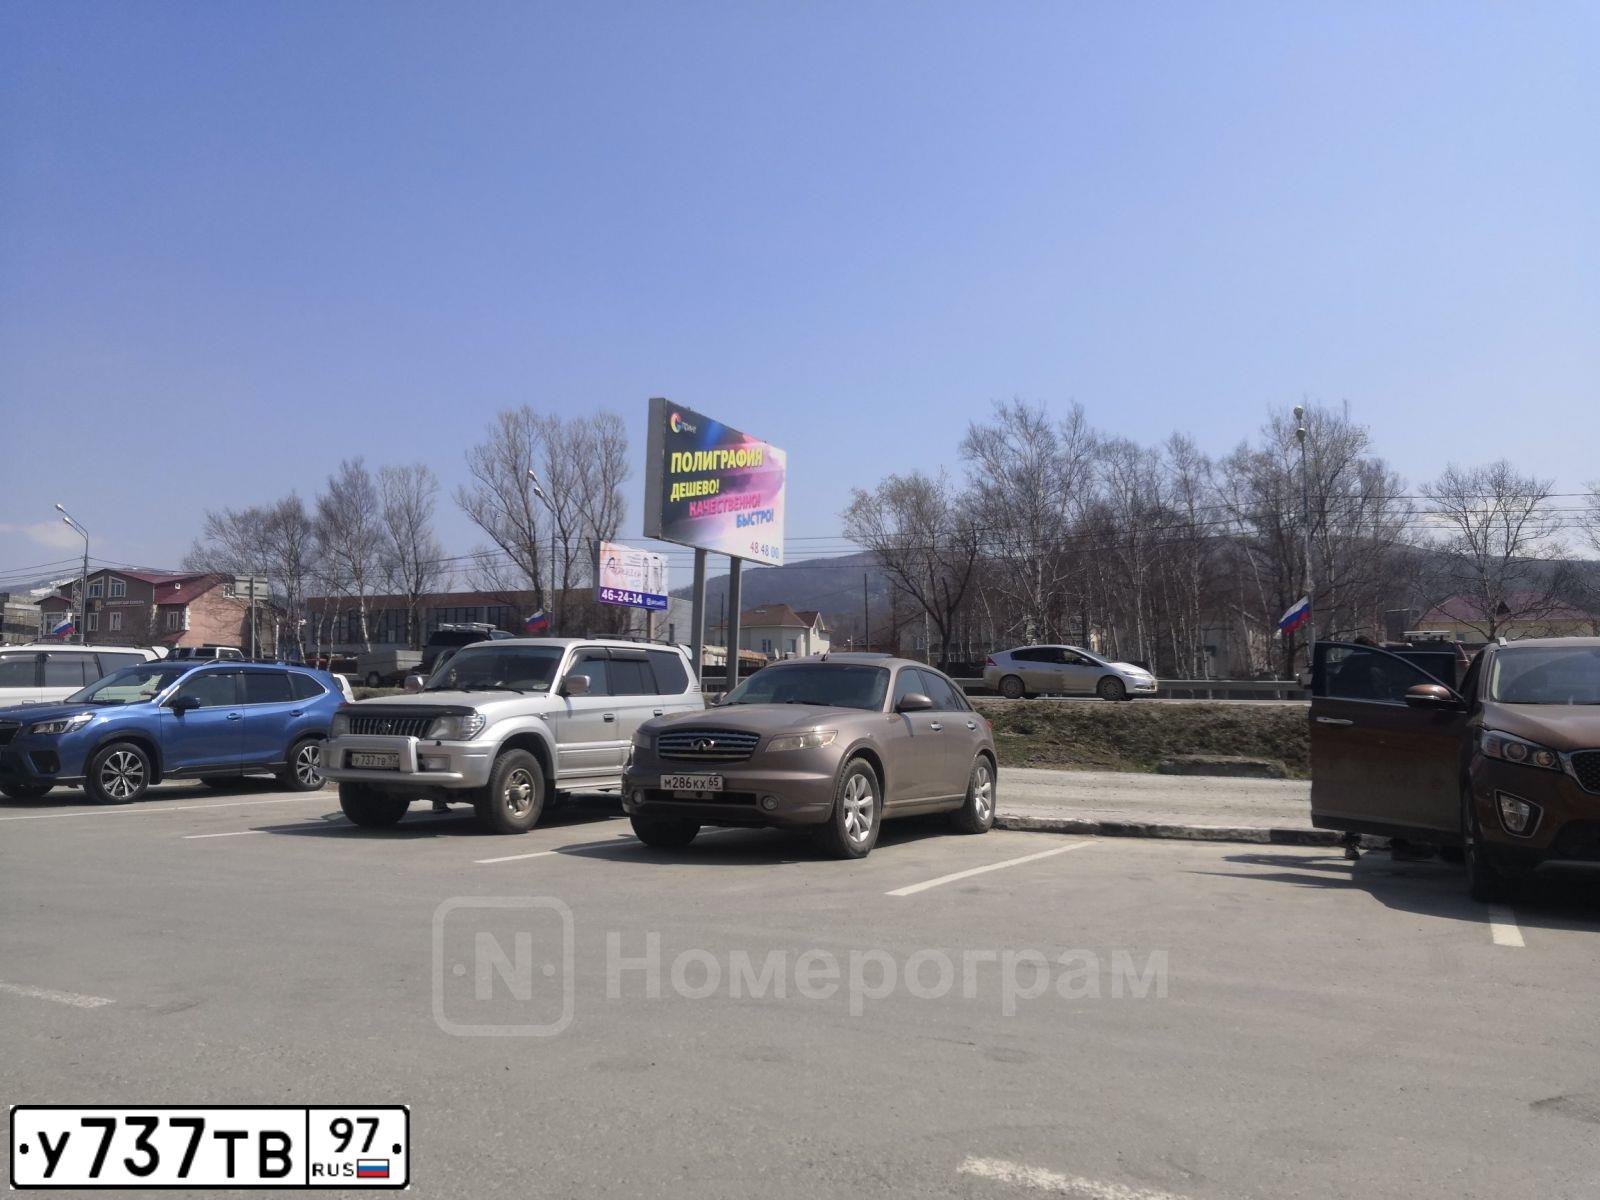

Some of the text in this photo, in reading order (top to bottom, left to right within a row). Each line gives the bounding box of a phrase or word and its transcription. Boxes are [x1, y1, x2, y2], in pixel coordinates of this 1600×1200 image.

[671, 448, 763, 473] ПОЛИГРАФИЯ
[671, 479, 719, 502] ДЕШЕВО!
[689, 494, 761, 517] КАЧЕСТВЕННО!
[736, 508, 774, 528] БЫСТРО!
[750, 541, 759, 554] 48
[761, 545, 769, 556] 48
[601, 589, 643, 604] 46-24-14
[664, 777, 719, 789] М286КХ 65
